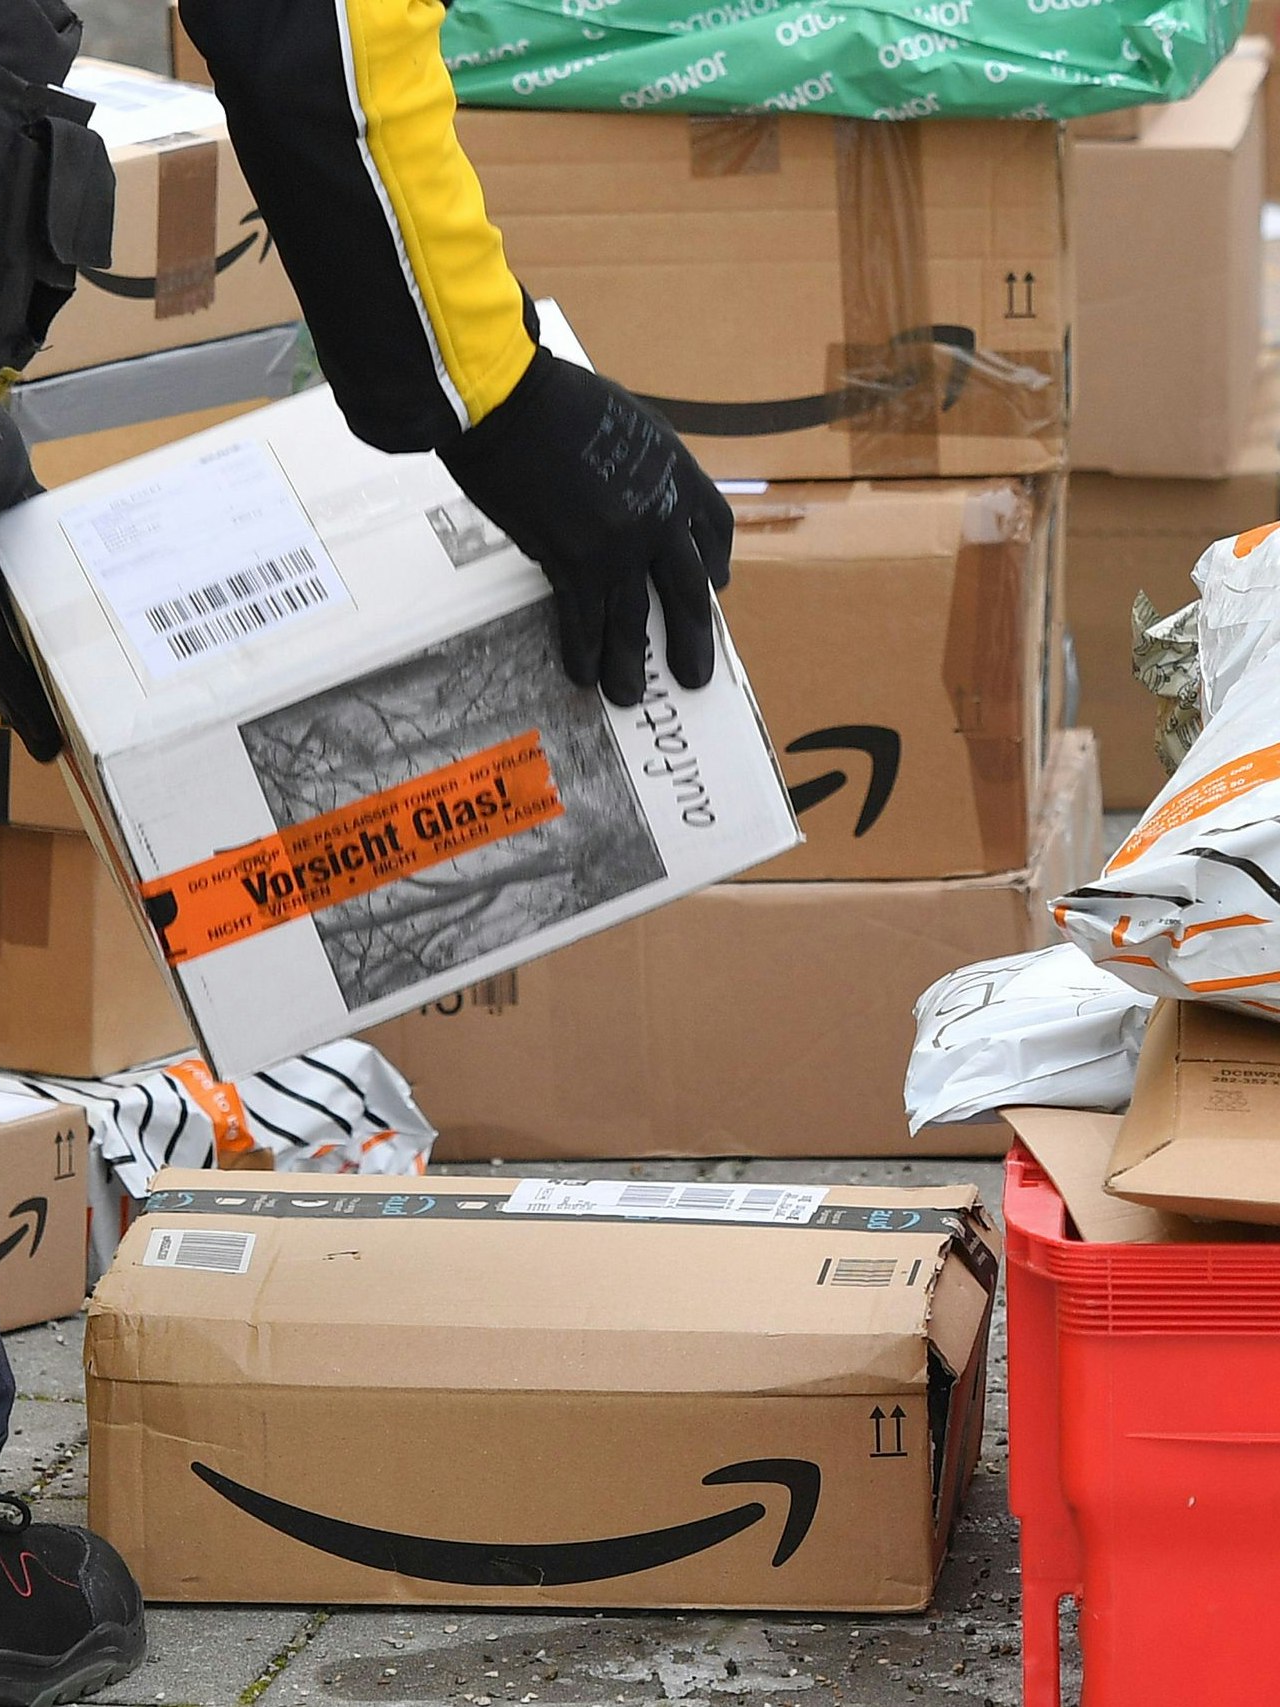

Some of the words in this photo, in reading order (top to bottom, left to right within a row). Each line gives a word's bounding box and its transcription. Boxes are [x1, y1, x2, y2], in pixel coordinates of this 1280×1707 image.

[619, 49, 730, 111] JOMODO
[188, 876, 209, 894] DO
[211, 865, 241, 886] NOT
[242, 847, 281, 875] DROP
[292, 838, 313, 854] NE
[314, 825, 340, 846] PAS
[342, 802, 400, 832] LAISSER
[403, 780, 459, 809] TOMBER
[469, 765, 490, 785] NO
[206, 913, 255, 943] NICHT
[268, 885, 332, 918] WERFEN
[372, 848, 417, 879] NICHT
[433, 822, 489, 854] FALLEN
[241, 821, 403, 906] Vorsicht
[412, 774, 512, 842] Glas!
